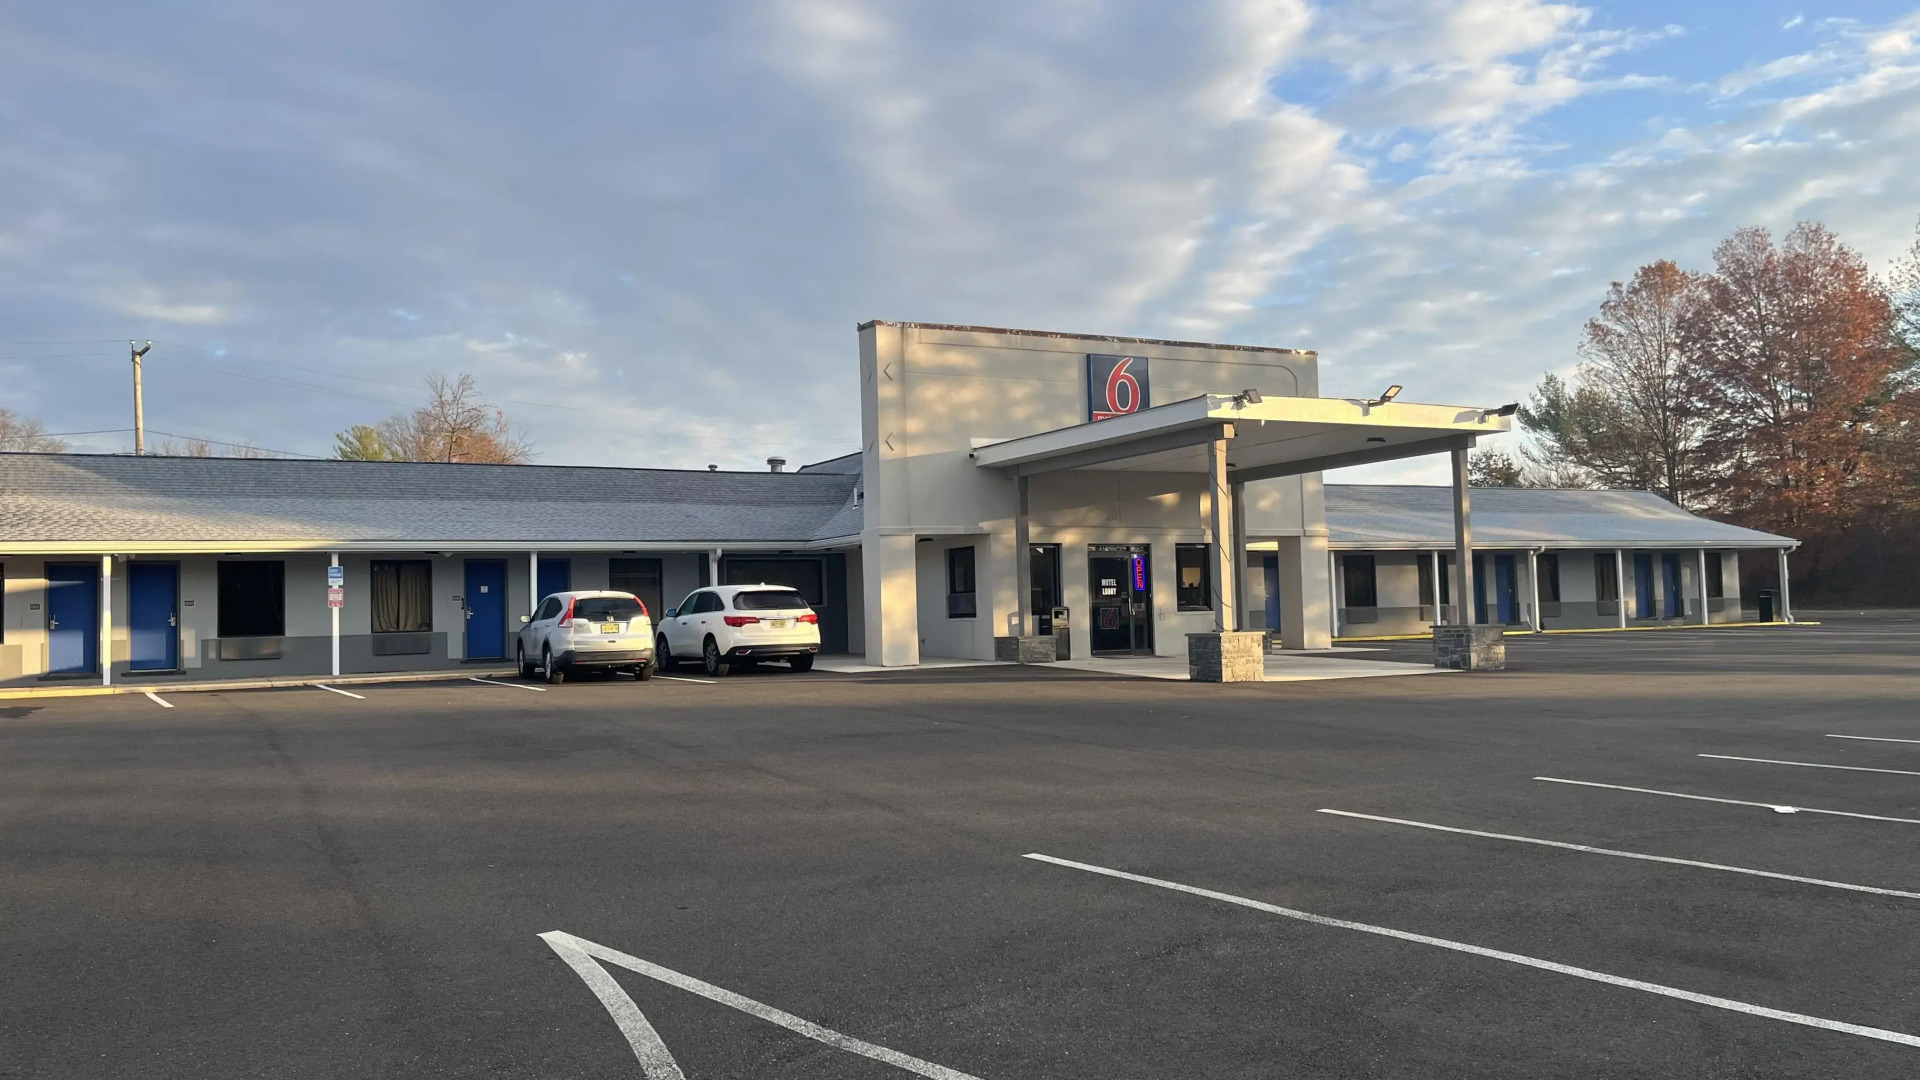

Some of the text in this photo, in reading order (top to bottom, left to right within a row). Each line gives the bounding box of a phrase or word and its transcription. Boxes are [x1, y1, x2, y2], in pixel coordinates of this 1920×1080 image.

[1106, 357, 1140, 413] 6
[1101, 579, 1117, 587] MOTEL
[1135, 558, 1144, 589] OPEN
